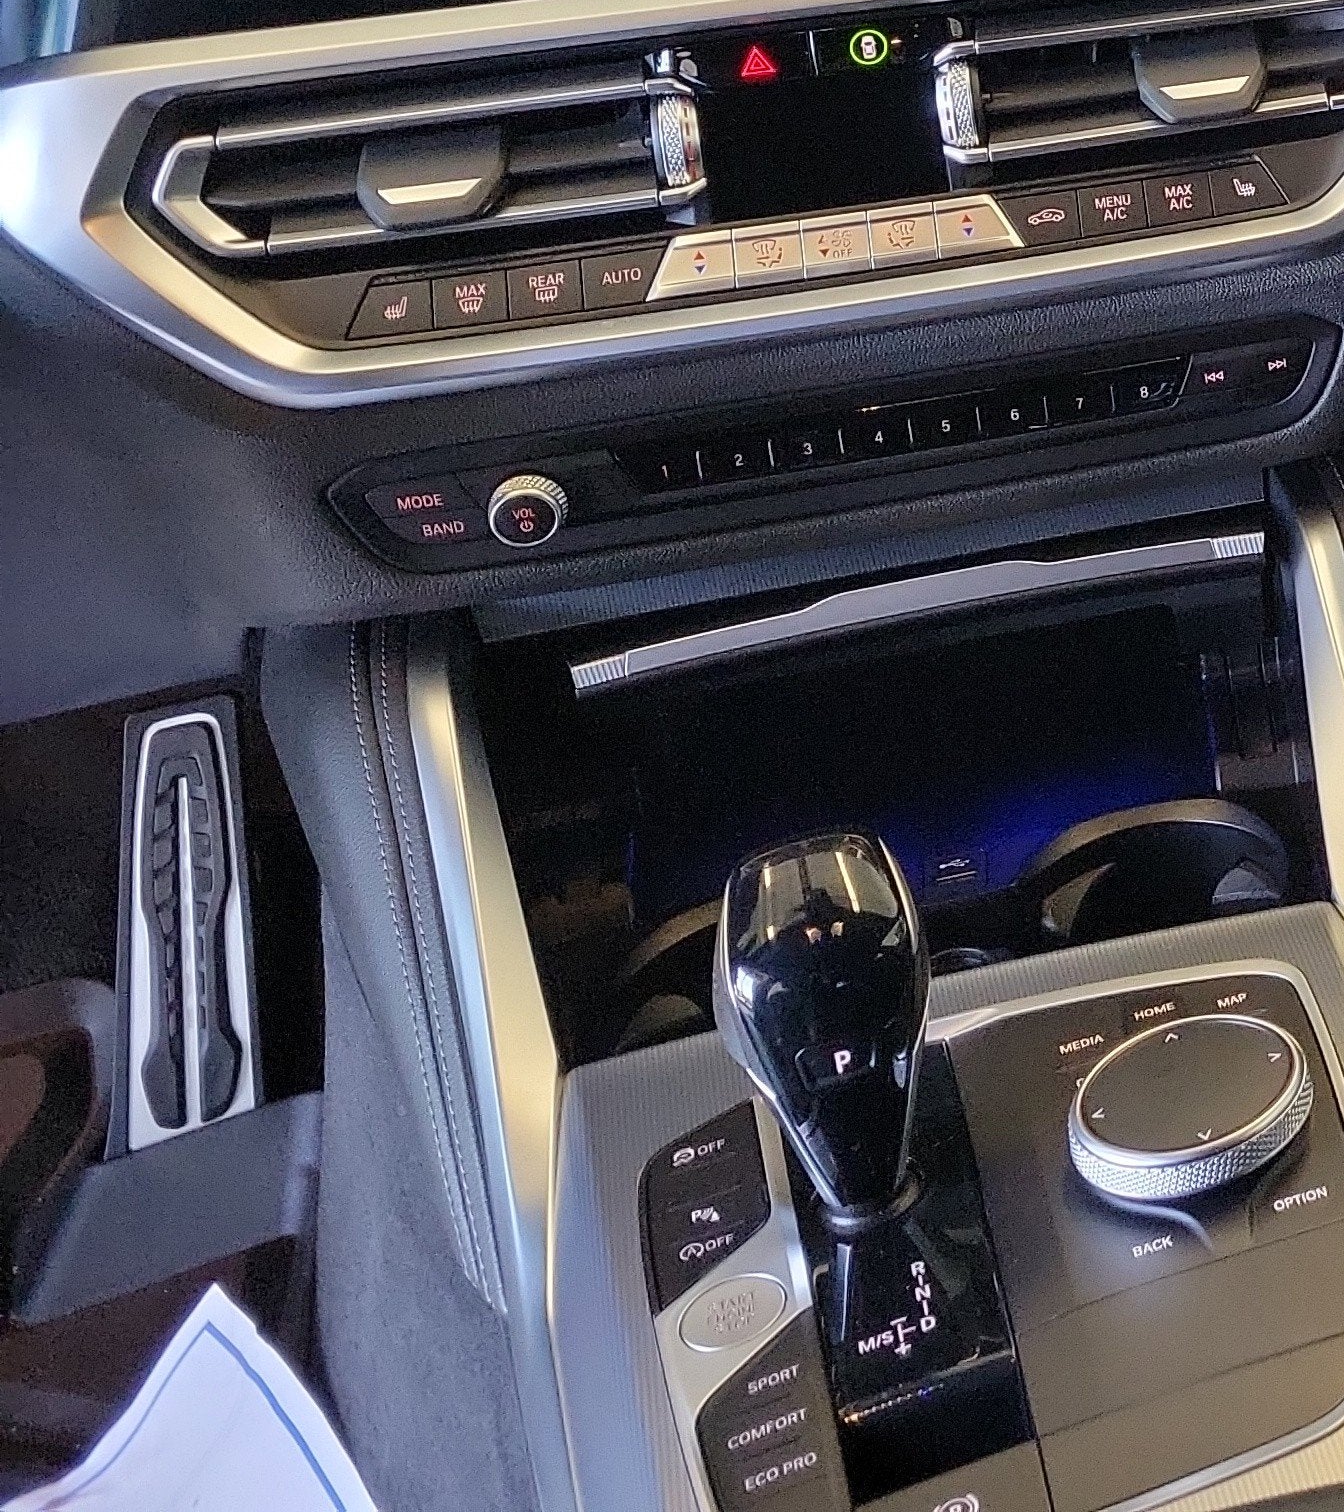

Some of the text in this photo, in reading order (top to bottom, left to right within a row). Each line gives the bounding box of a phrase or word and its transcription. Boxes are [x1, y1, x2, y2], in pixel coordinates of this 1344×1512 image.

[1164, 183, 1193, 199] MAX
[1094, 193, 1132, 210] MENU
[1169, 196, 1193, 211] A/C
[1103, 207, 1128, 223] A/C
[832, 248, 853, 259] OFF
[528, 271, 565, 289] REAR
[601, 267, 643, 286] AUTO
[455, 283, 487, 299] MAX
[1139, 386, 1150, 399] 8
[1075, 397, 1084, 410] 7
[1010, 408, 1020, 421] 6
[941, 419, 951, 433] 5
[874, 430, 884, 444] 4
[803, 442, 813, 455] 3
[733, 453, 744, 467] 2
[396, 493, 445, 512] MODE
[511, 507, 536, 521] VOL
[422, 520, 466, 538] BAND
[1216, 992, 1248, 1010] MAP
[1133, 1001, 1177, 1022] HOME
[1058, 1033, 1105, 1056] MEDIA
[833, 1049, 852, 1075] P
[697, 1138, 727, 1157] OFF
[1273, 1185, 1329, 1213] OPTION
[705, 1232, 735, 1251] OFF
[1131, 1234, 1174, 1259] BACK
[910, 1261, 926, 1278] R
[914, 1283, 932, 1303] N
[920, 1316, 937, 1334] D
[857, 1329, 895, 1356] M/S
[747, 1363, 800, 1396] SPORT
[727, 1407, 808, 1451] COMFORT
[744, 1451, 818, 1493] ECO PRO
